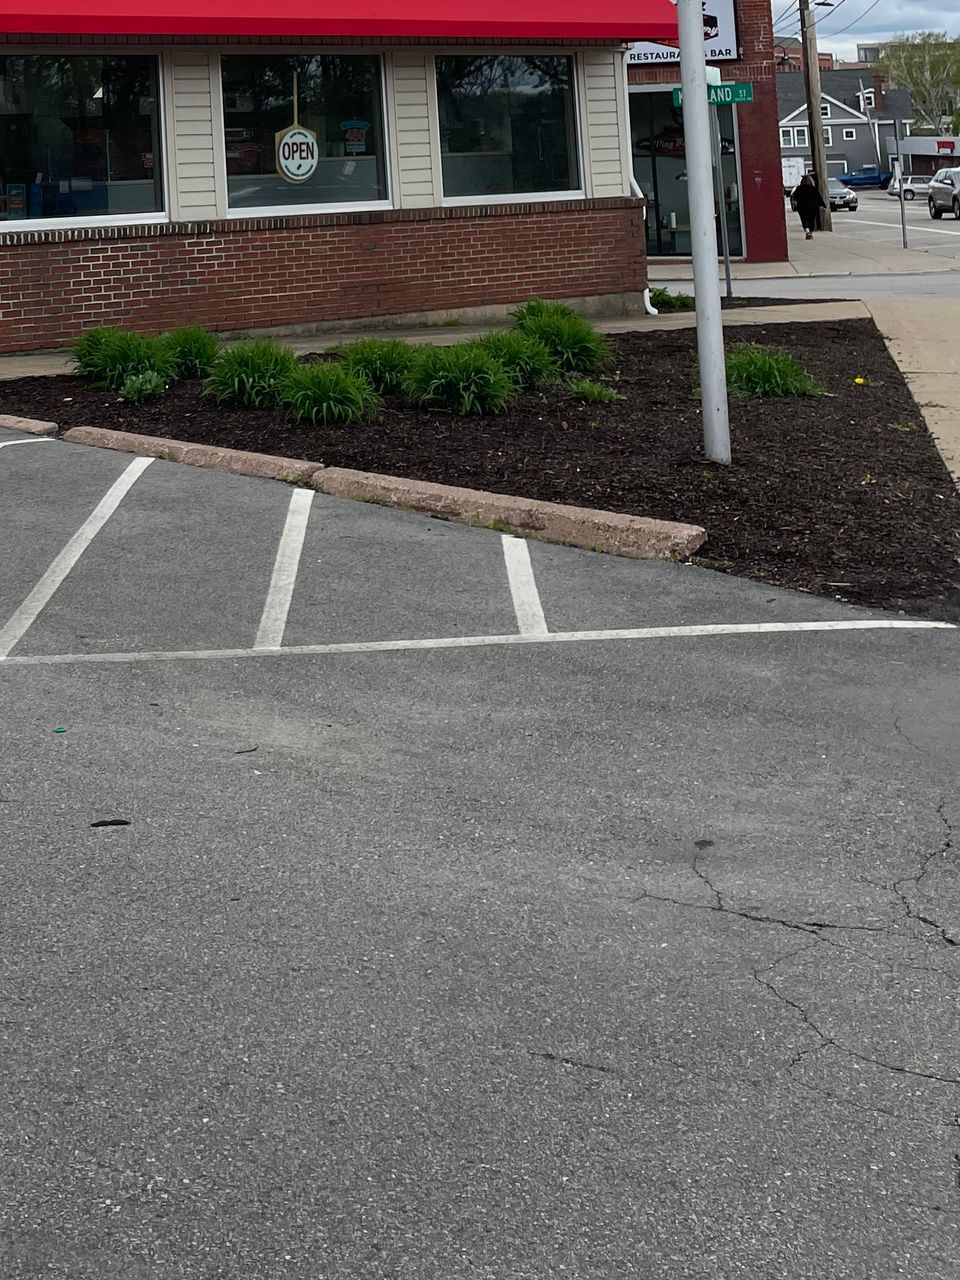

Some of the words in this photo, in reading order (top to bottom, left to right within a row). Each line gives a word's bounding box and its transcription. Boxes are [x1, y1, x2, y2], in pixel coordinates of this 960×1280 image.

[629, 51, 681, 61] RESTAURA
[711, 49, 732, 58] BAR
[282, 141, 315, 161] OPEN
